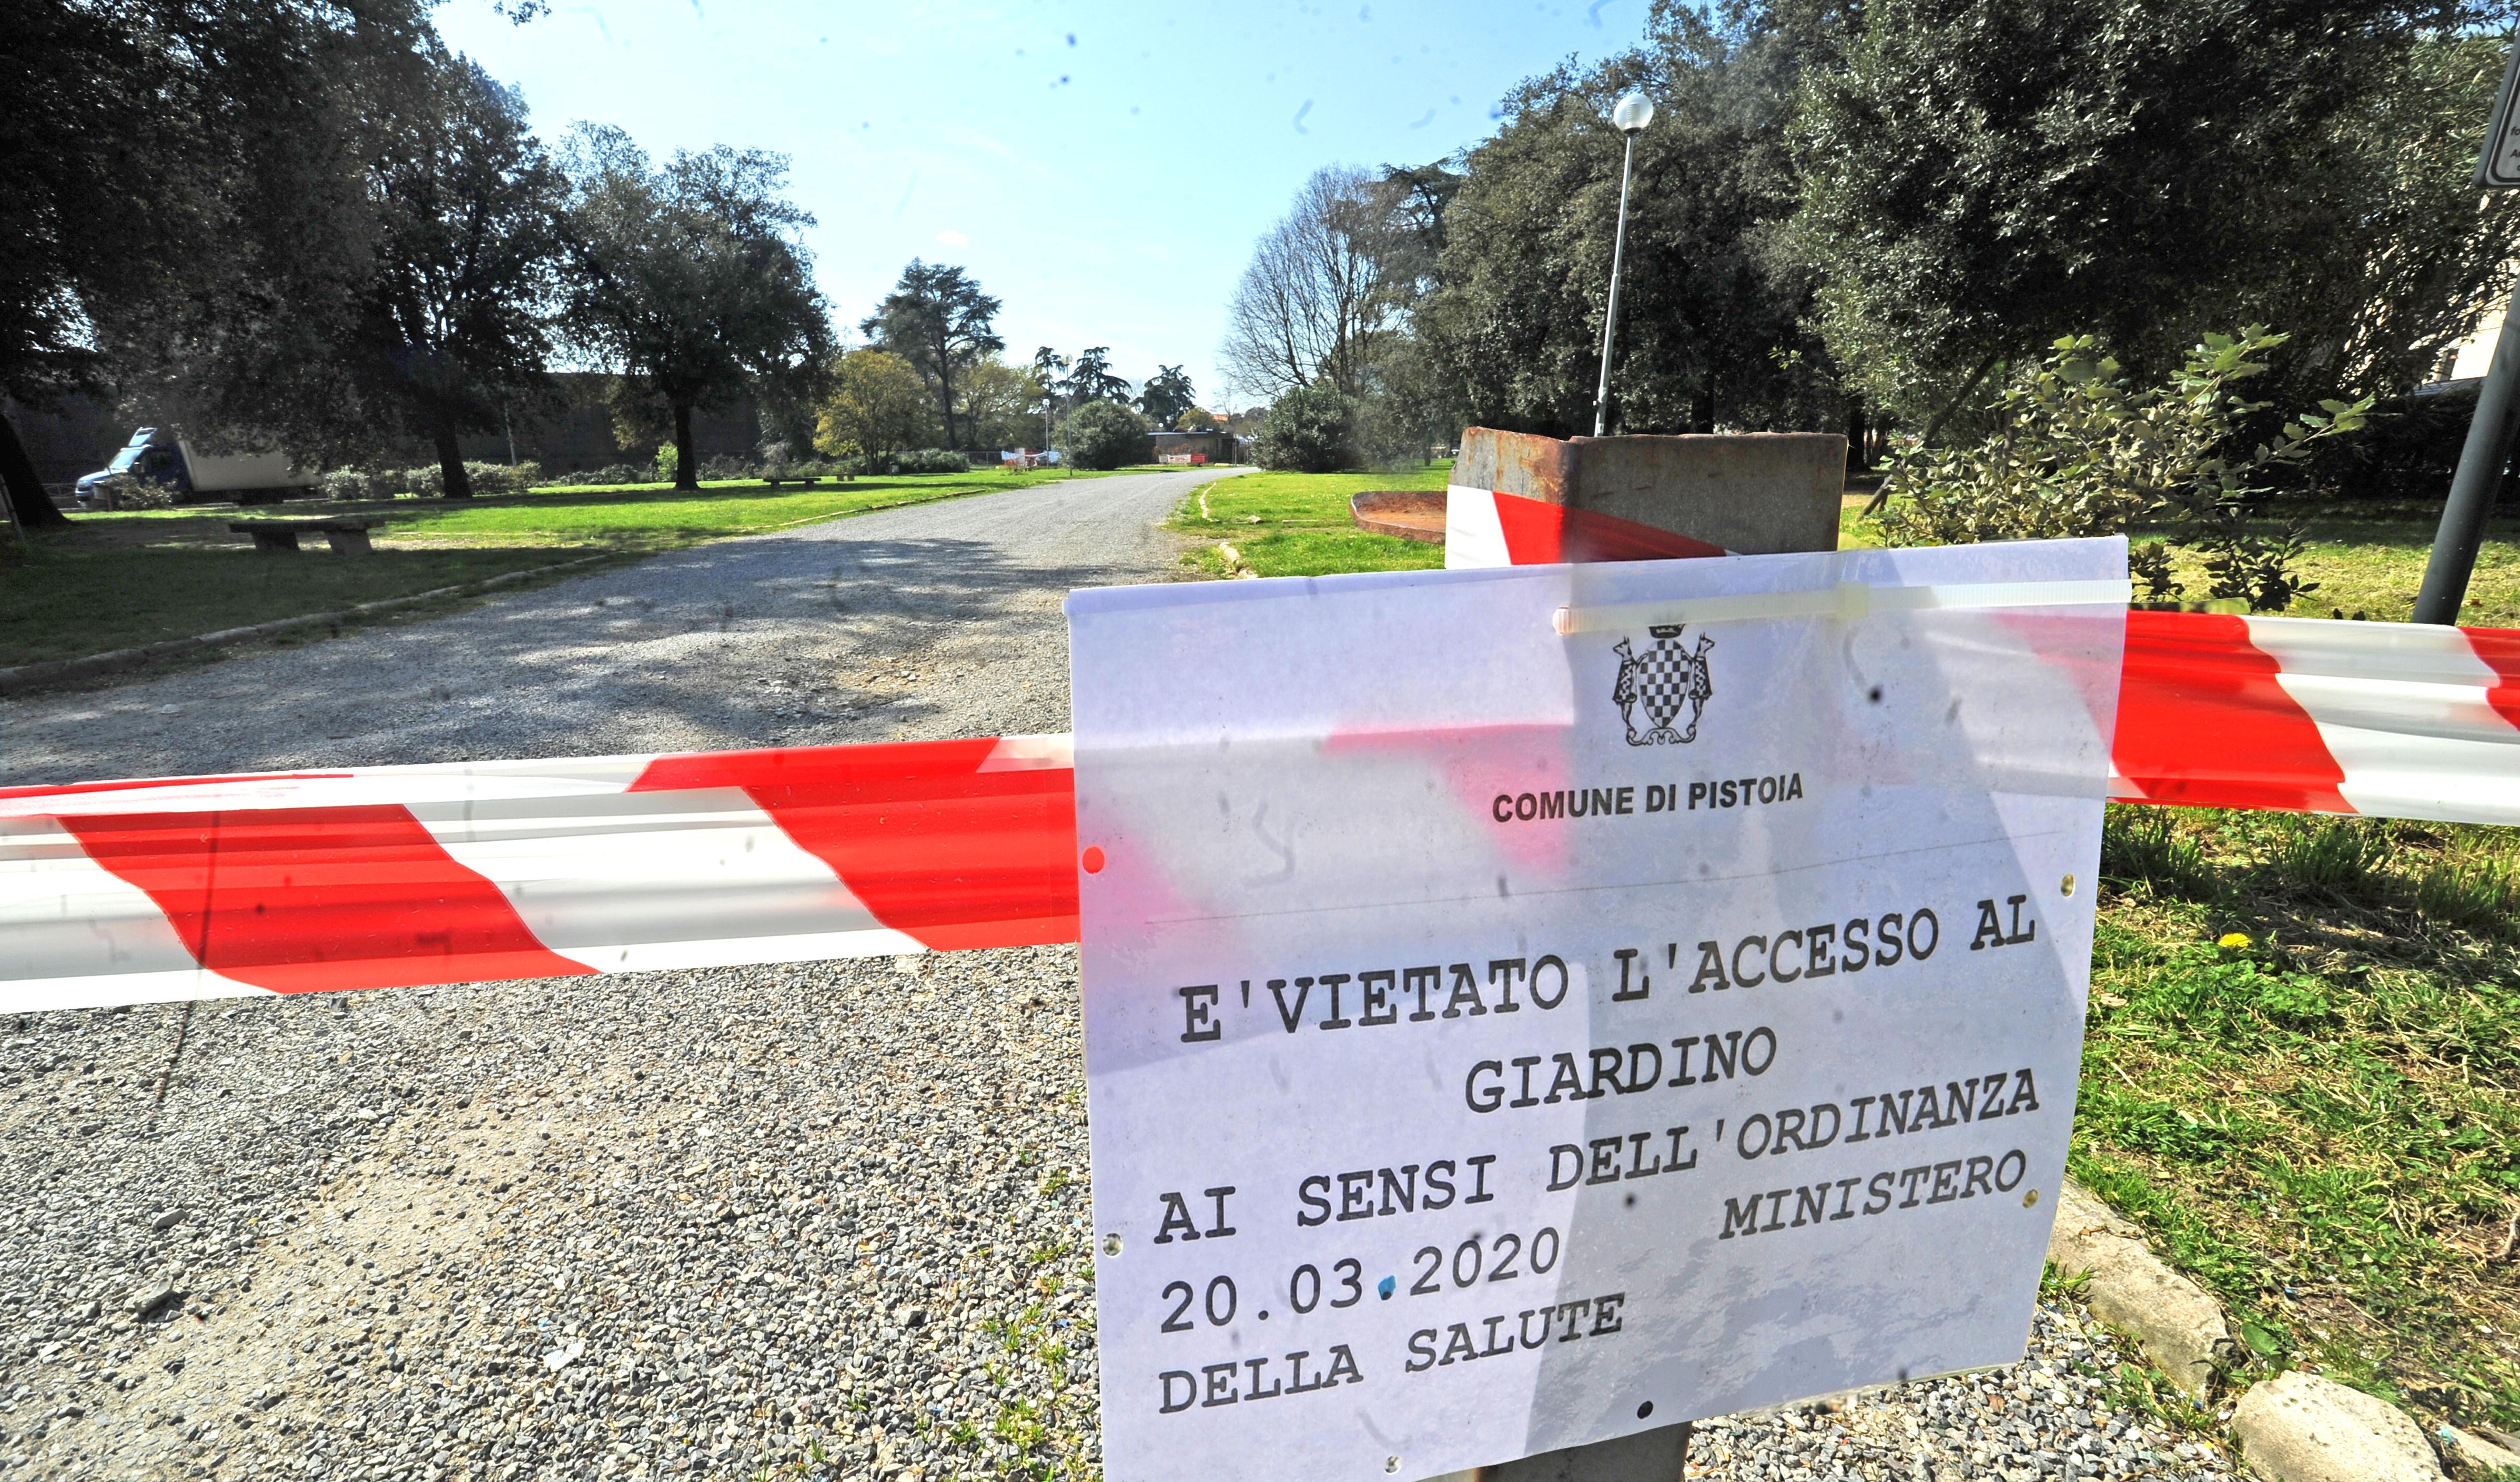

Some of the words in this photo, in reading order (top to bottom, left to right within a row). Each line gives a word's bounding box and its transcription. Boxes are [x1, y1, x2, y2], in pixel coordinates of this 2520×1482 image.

[1492, 787, 1634, 822] COMUNE
[1646, 784, 1676, 813] DI
[1688, 772, 1804, 810] PISTOIA
[1178, 954, 1568, 1043] E'VIETATO
[1612, 907, 1939, 1002] L'ACCESSO
[1969, 893, 2036, 951] AL
[1465, 1026, 1777, 1114] GIARDINO
[1153, 1185, 1237, 1245] AI
[1297, 1154, 1497, 1227] SENSI
[1546, 1067, 2040, 1193] DELL'ORDINANZA
[1160, 1226, 1560, 1334] 20.03.2020
[1718, 1148, 2027, 1241] MINISTERO
[1158, 1344, 1364, 1415] DELLA
[1405, 1292, 1625, 1373] SALUTE
